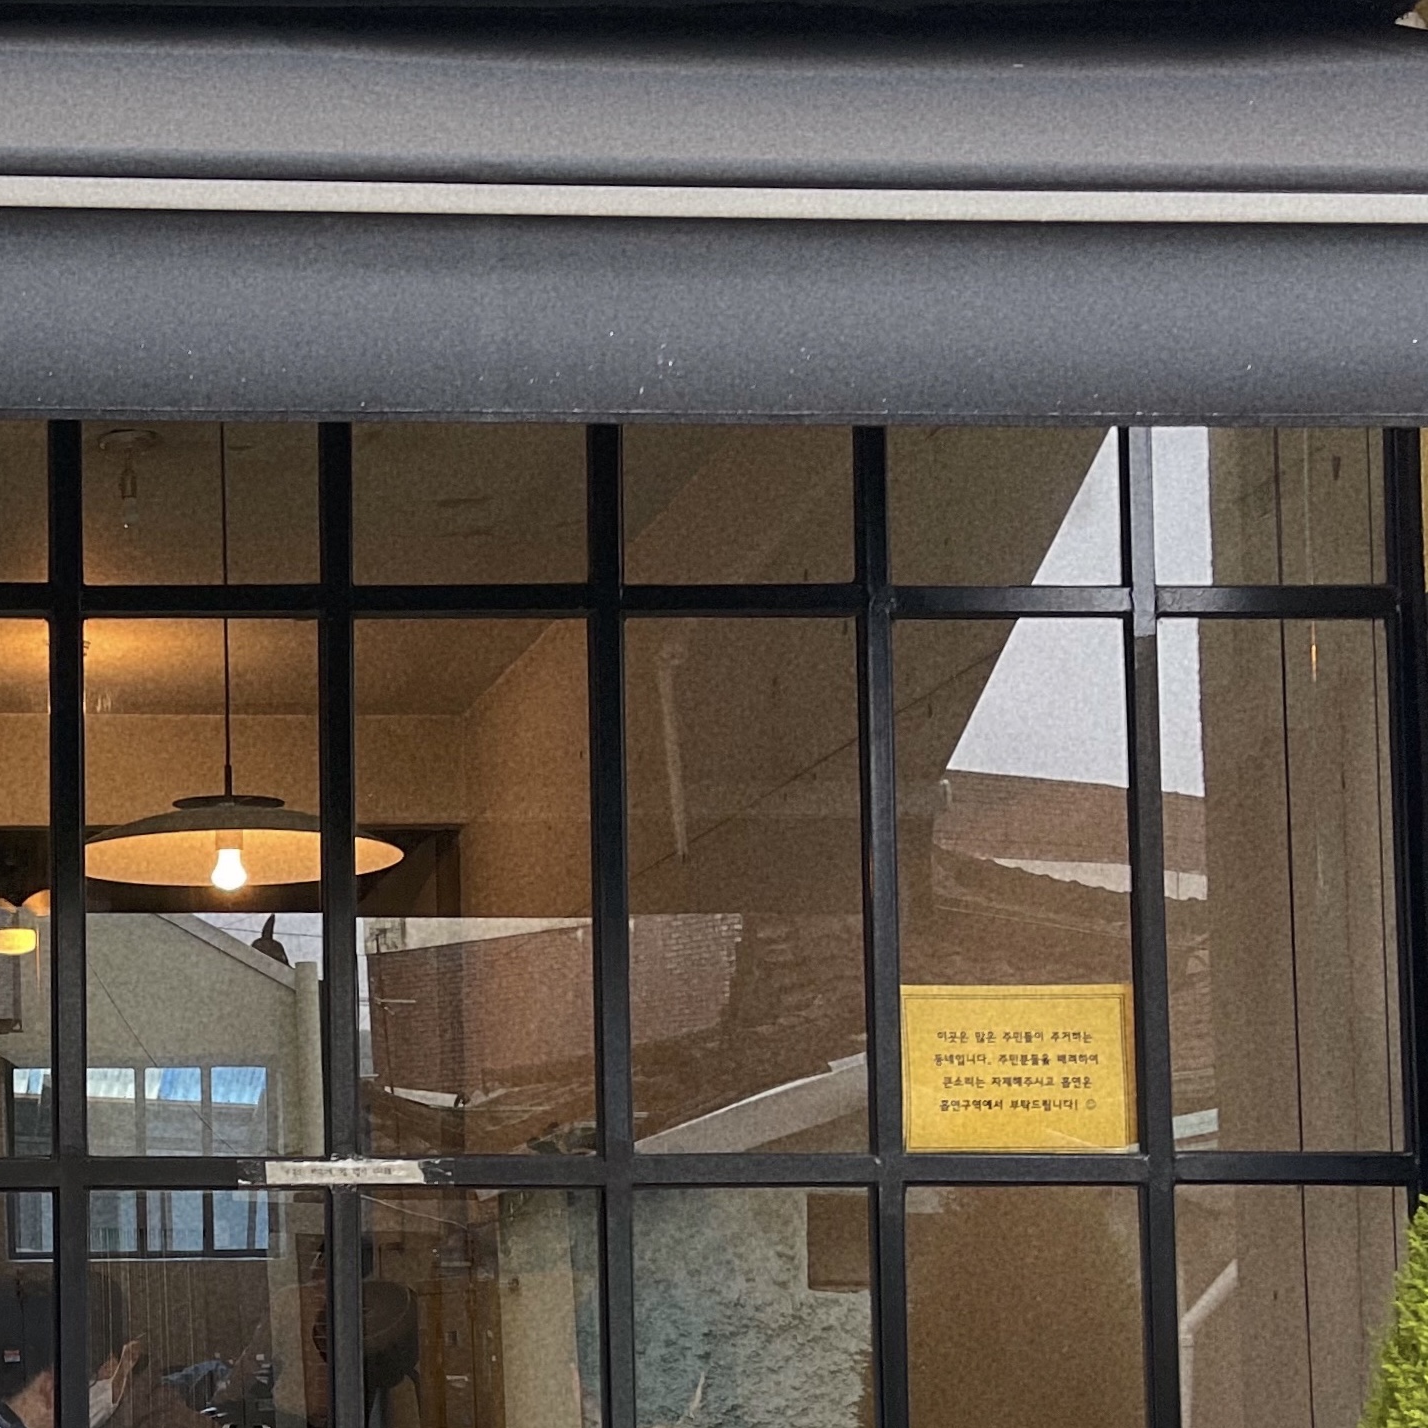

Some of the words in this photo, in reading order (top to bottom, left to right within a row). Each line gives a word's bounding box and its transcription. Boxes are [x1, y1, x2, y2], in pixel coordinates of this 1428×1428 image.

[936, 1031, 969, 1044] 이곳은
[974, 1031, 997, 1044] 많은
[1002, 1031, 1044, 1044] 주민들이
[1050, 1031, 1093, 1044] 주거하는
[933, 1053, 992, 1067] 동네입니다.
[997, 1053, 1051, 1066] 주민분들을
[1056, 1053, 1099, 1066] 배려하여
[942, 1076, 986, 1089] 큰소리는
[991, 1076, 1055, 1089] 자제해주시고
[1060, 1076, 1092, 1089] 흡연은
[939, 1099, 1003, 1112] 흡연구역에서
